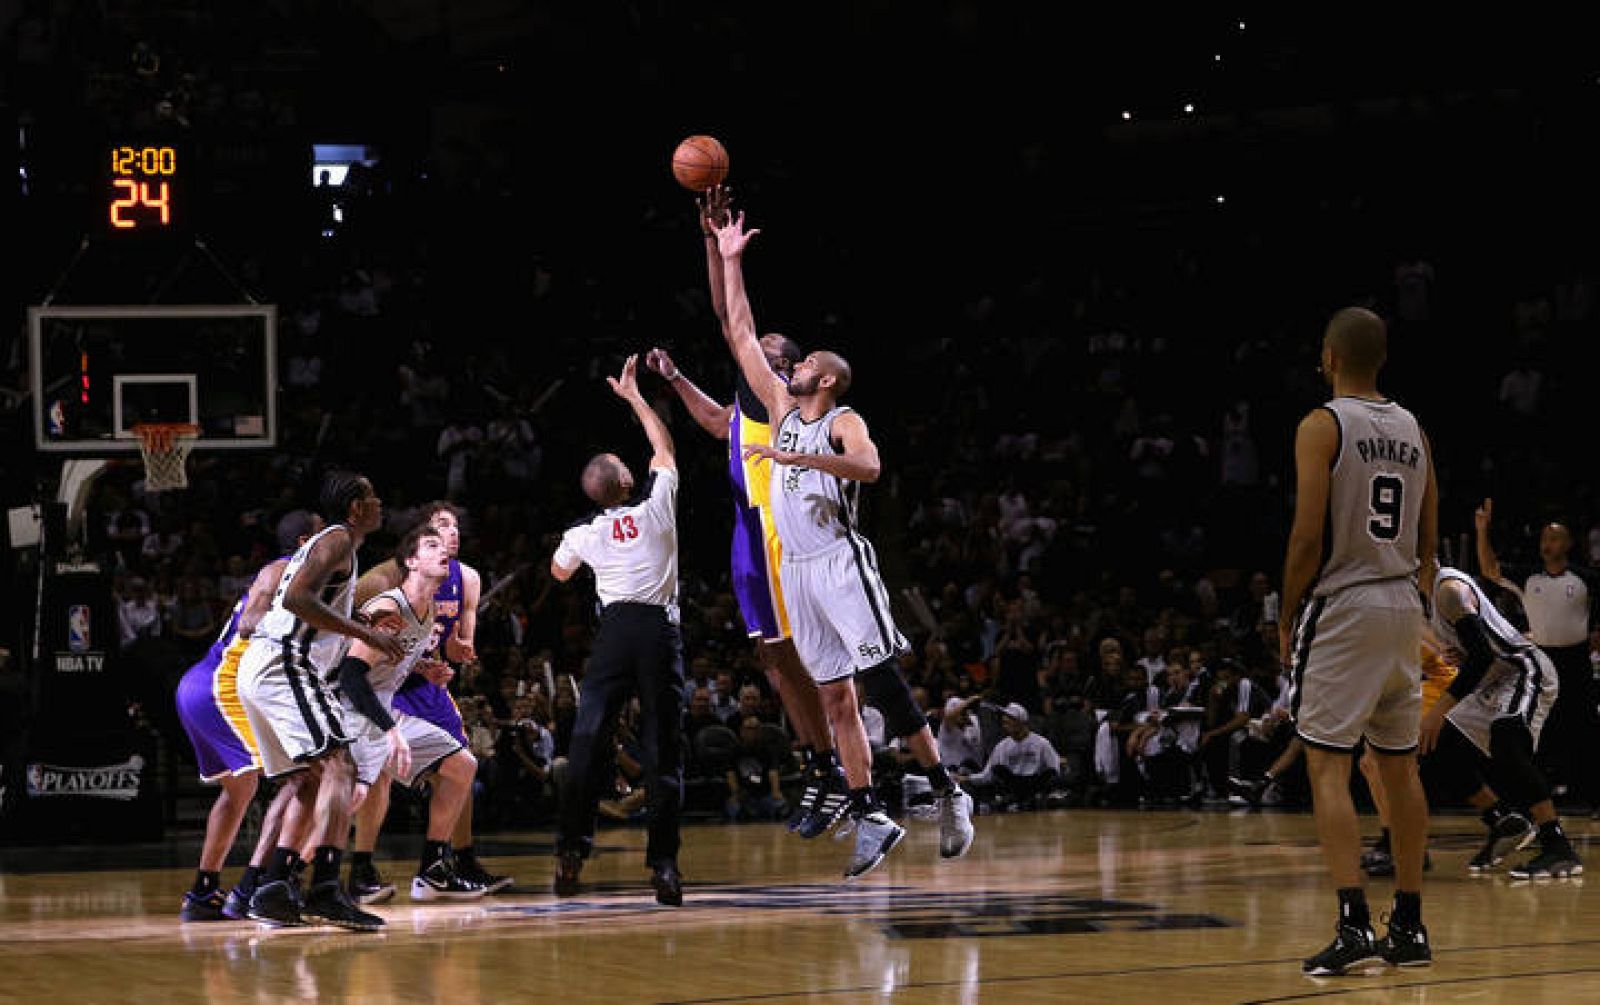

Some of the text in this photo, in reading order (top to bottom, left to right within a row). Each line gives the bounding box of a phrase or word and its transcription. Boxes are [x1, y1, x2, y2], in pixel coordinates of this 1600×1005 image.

[112, 147, 176, 174] 12:00
[110, 179, 169, 228] 24
[1356, 439, 1420, 468] PARKER
[1367, 474, 1404, 542] 9
[612, 515, 639, 542] 43
[56, 655, 104, 672] NBA TV
[43, 770, 140, 791] PLAYOFFS
